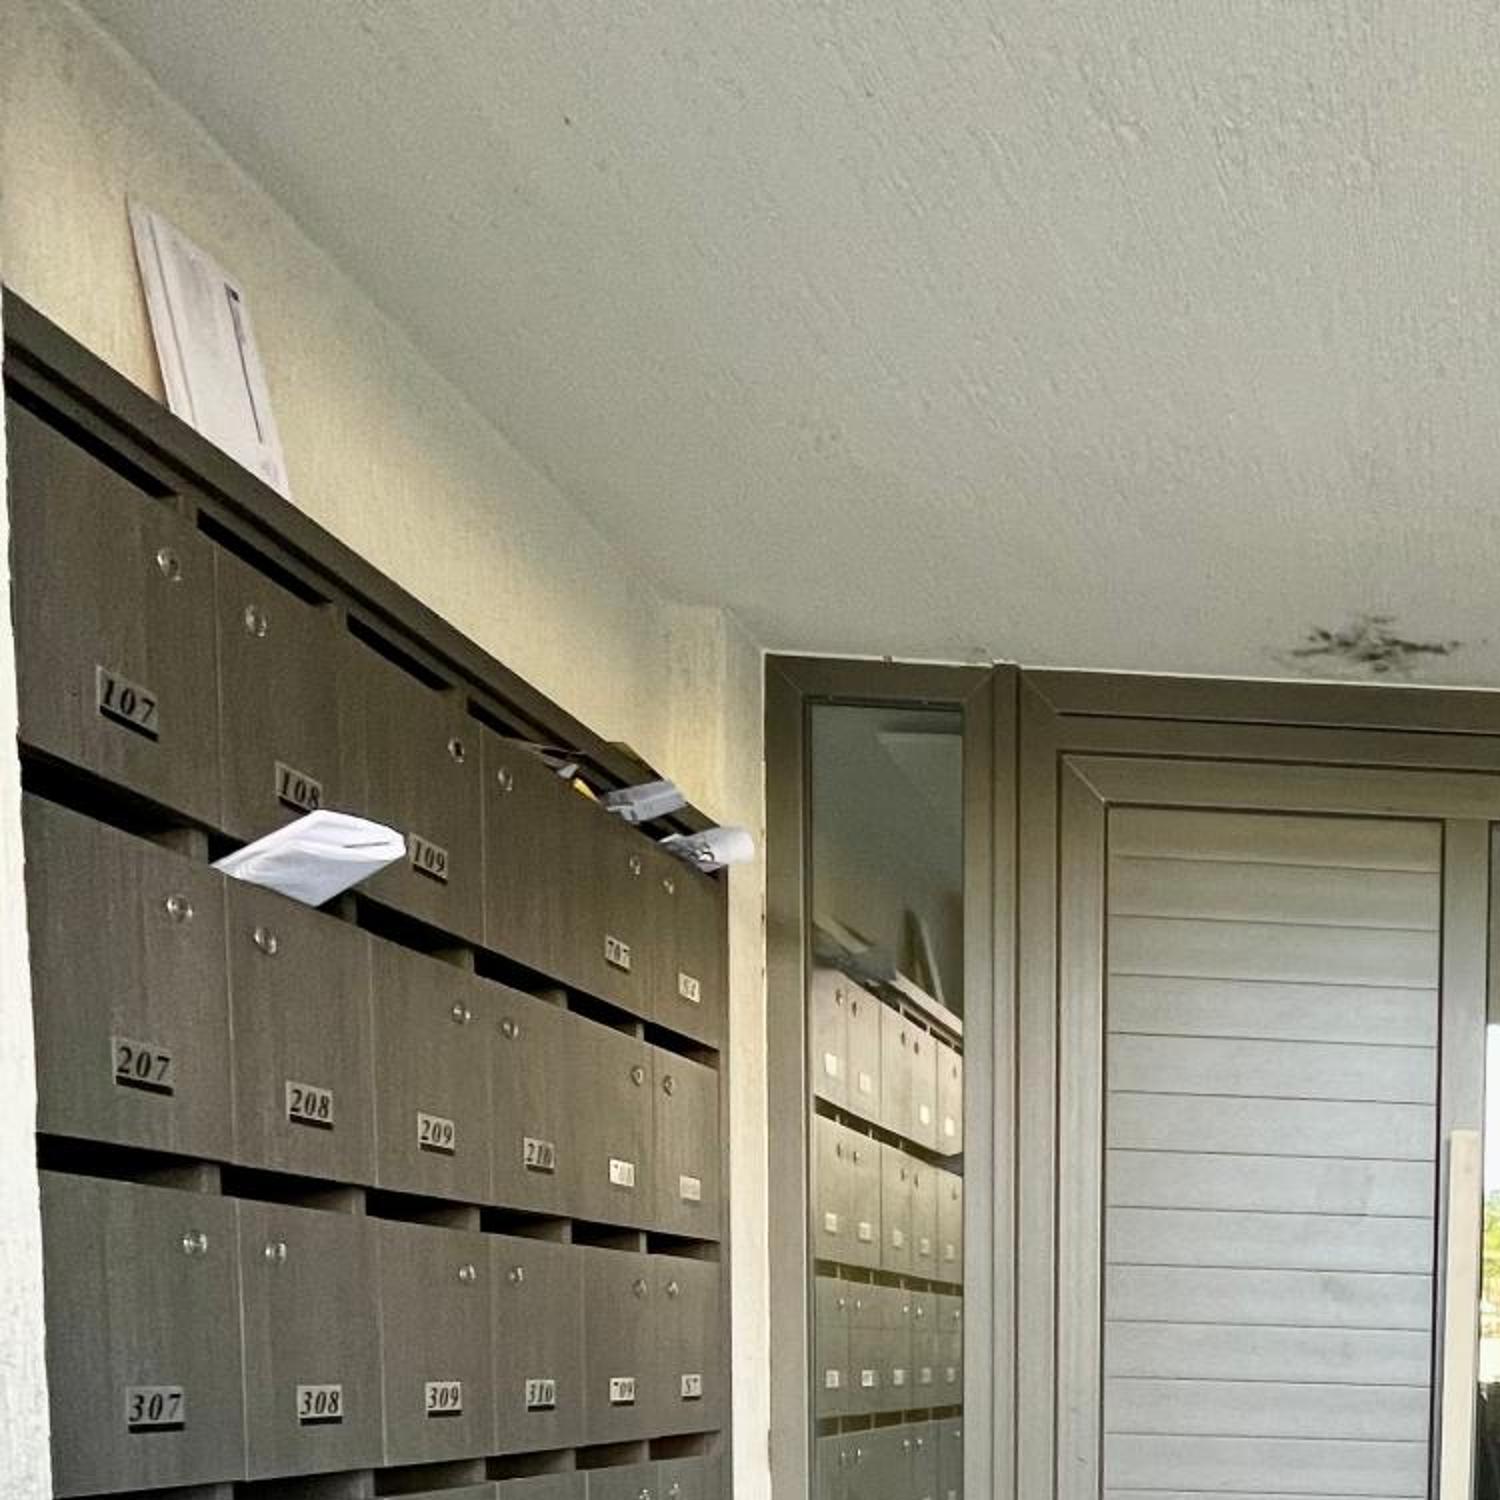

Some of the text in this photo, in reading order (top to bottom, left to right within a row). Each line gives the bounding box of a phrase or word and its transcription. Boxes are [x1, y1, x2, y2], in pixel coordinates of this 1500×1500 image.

[102, 680, 156, 723] 107
[281, 771, 320, 811] 108
[413, 842, 446, 873] 109
[117, 1046, 170, 1082] 207
[290, 1089, 330, 1119] 208
[421, 1119, 453, 1145] 209
[129, 1393, 181, 1422] 307
[300, 1391, 340, 1416] 308
[428, 1386, 460, 1409] 309
